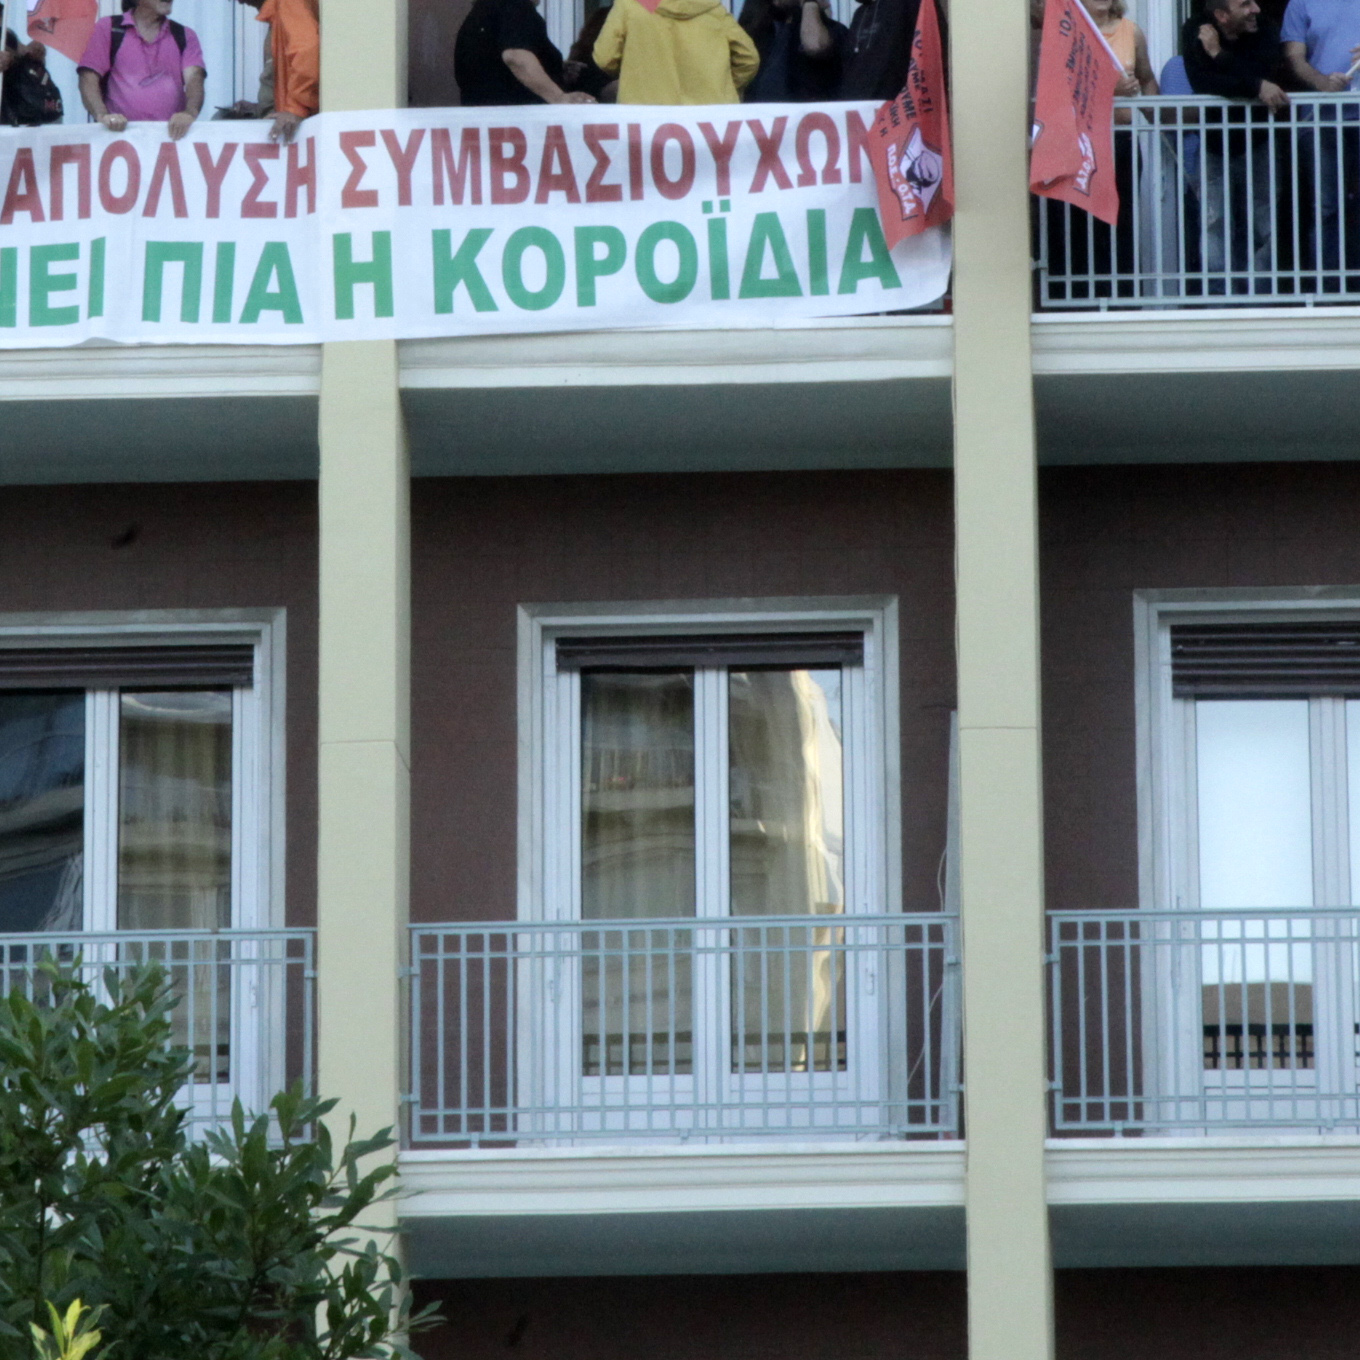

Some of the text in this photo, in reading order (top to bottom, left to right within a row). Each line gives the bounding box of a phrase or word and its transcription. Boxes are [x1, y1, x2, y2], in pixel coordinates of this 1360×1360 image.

[0, 135, 317, 223] ΑΠΟΛΥΣΗ
[339, 108, 880, 209] ΣΥΜΒΑΣΙΟΥΧΩΝ
[141, 240, 304, 325] ΠΙΑ
[332, 230, 394, 320] Η
[431, 199, 903, 316] ΚΟΡΟΪΔΙΑ
